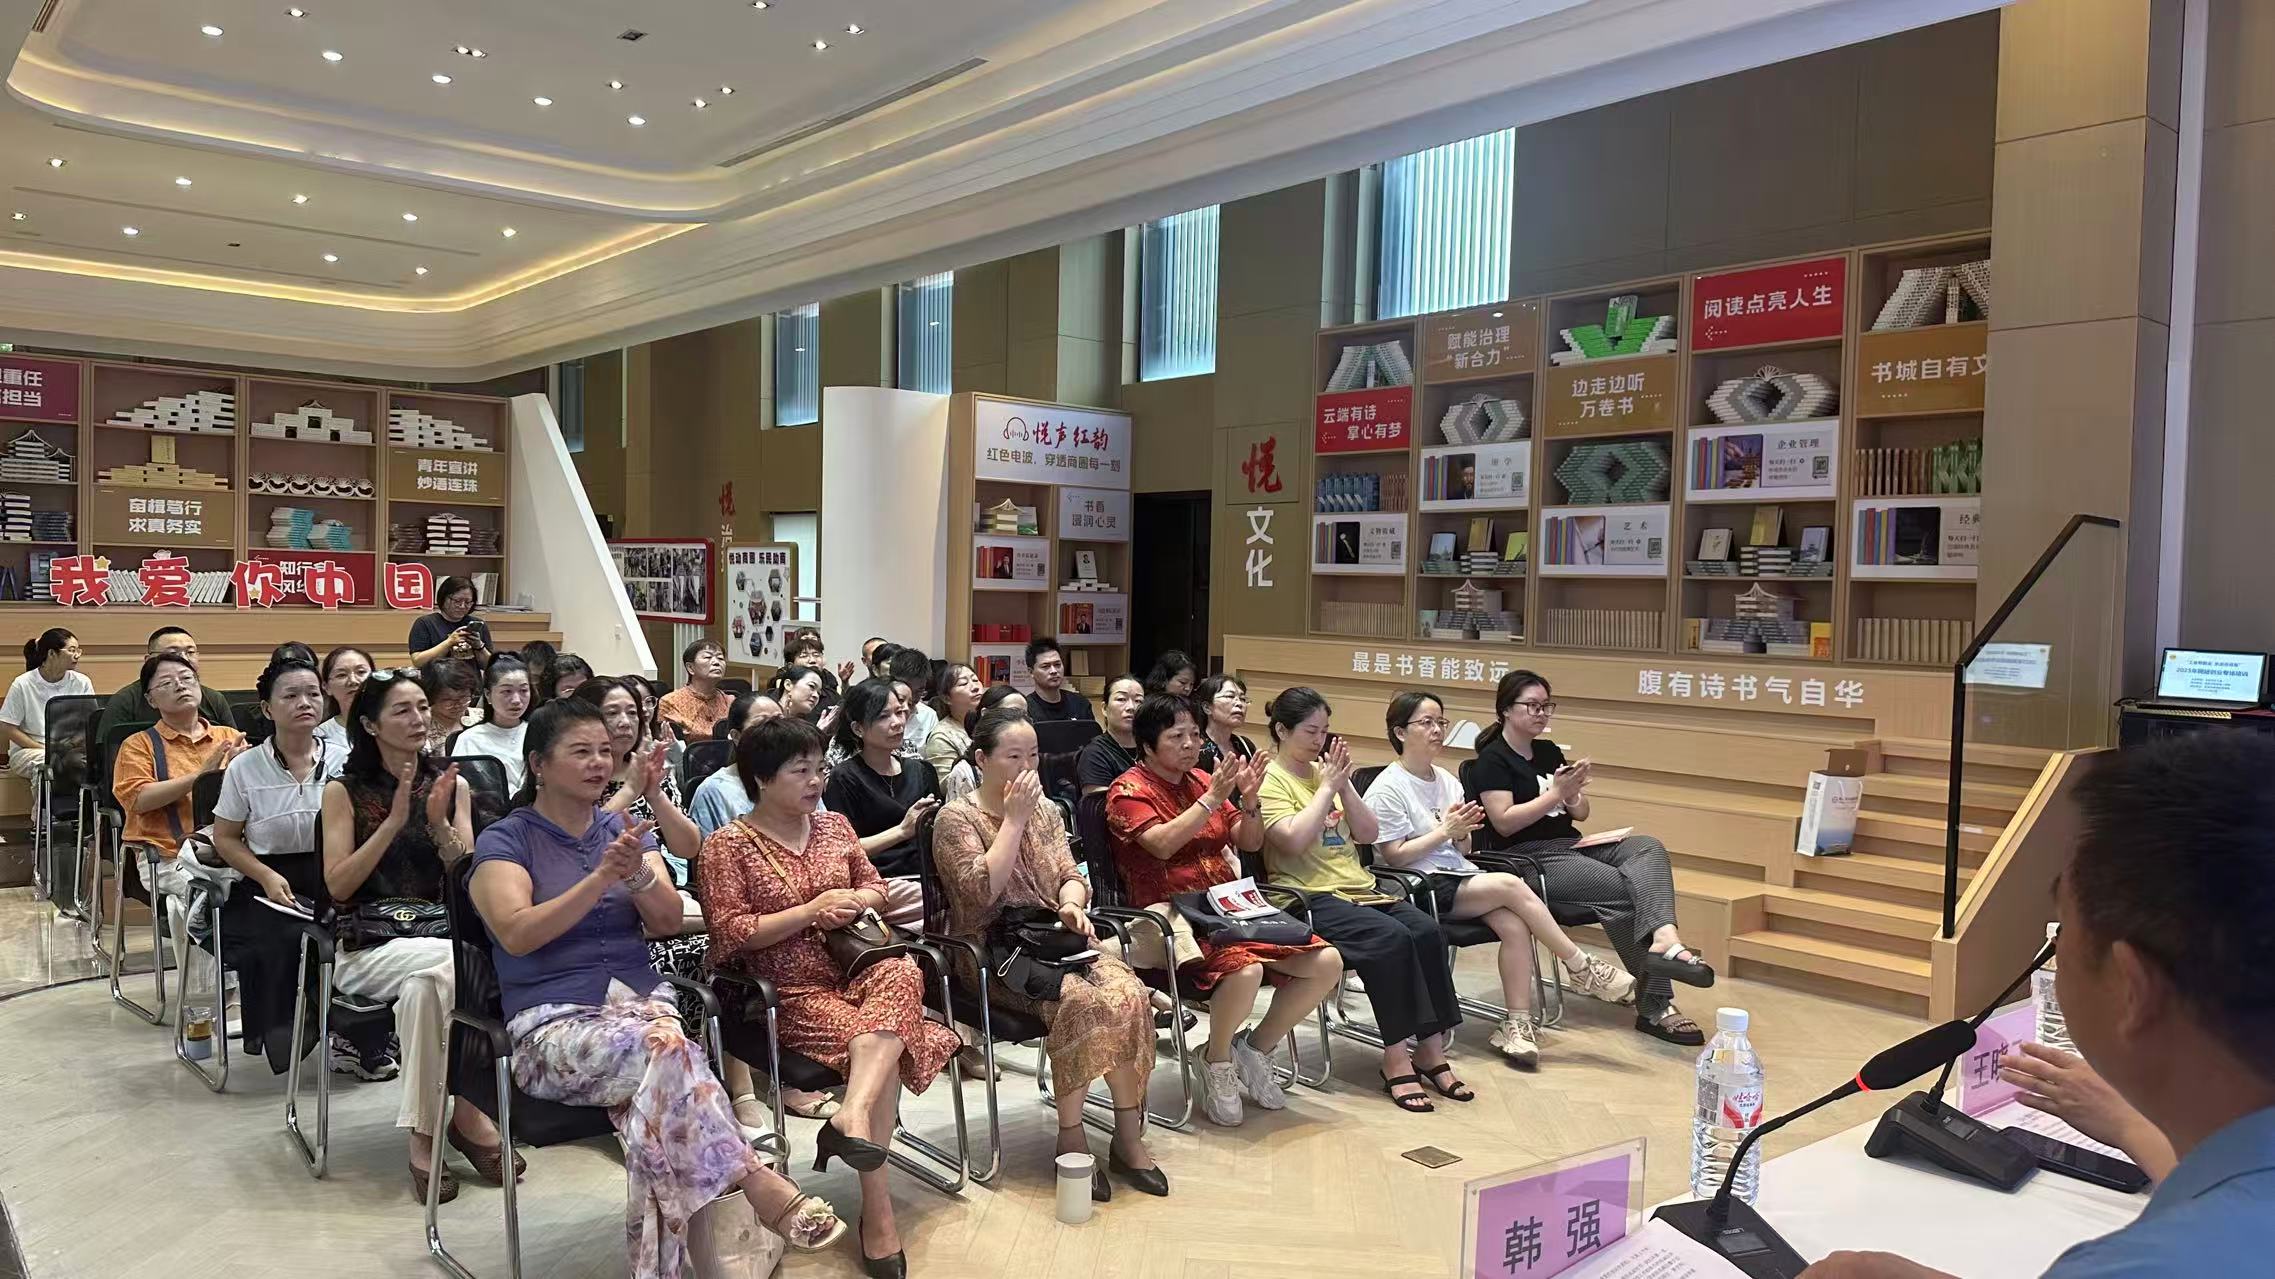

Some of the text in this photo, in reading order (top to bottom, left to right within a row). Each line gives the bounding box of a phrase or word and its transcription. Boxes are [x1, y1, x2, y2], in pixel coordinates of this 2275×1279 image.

[1704, 285, 1832, 319] 阅读点亮人生
[1447, 325, 1510, 350] 赋能治理
[0, 368, 42, 387] 重任
[1571, 372, 1645, 398] 边走边听
[0, 388, 42, 407] 担当
[1579, 397, 1634, 418] 万卷书
[1323, 404, 1377, 424] 云端有诗
[1032, 420, 1110, 452] 悦声红韵
[1347, 421, 1402, 440] 掌心有梦
[1777, 438, 1825, 451] 企业管理
[417, 458, 478, 476] 青年宣讲
[416, 475, 478, 493] 妙语连珠
[1085, 500, 1105, 513] 书香
[1241, 436, 1283, 588] 悦 文化
[128, 518, 202, 535] 求真务实
[50, 553, 434, 610] 我爱你中国
[1352, 651, 1510, 683] 最是书香能致远
[1637, 669, 1865, 709] 腹有诗书气自华
[1502, 1199, 1602, 1275] 韩强
